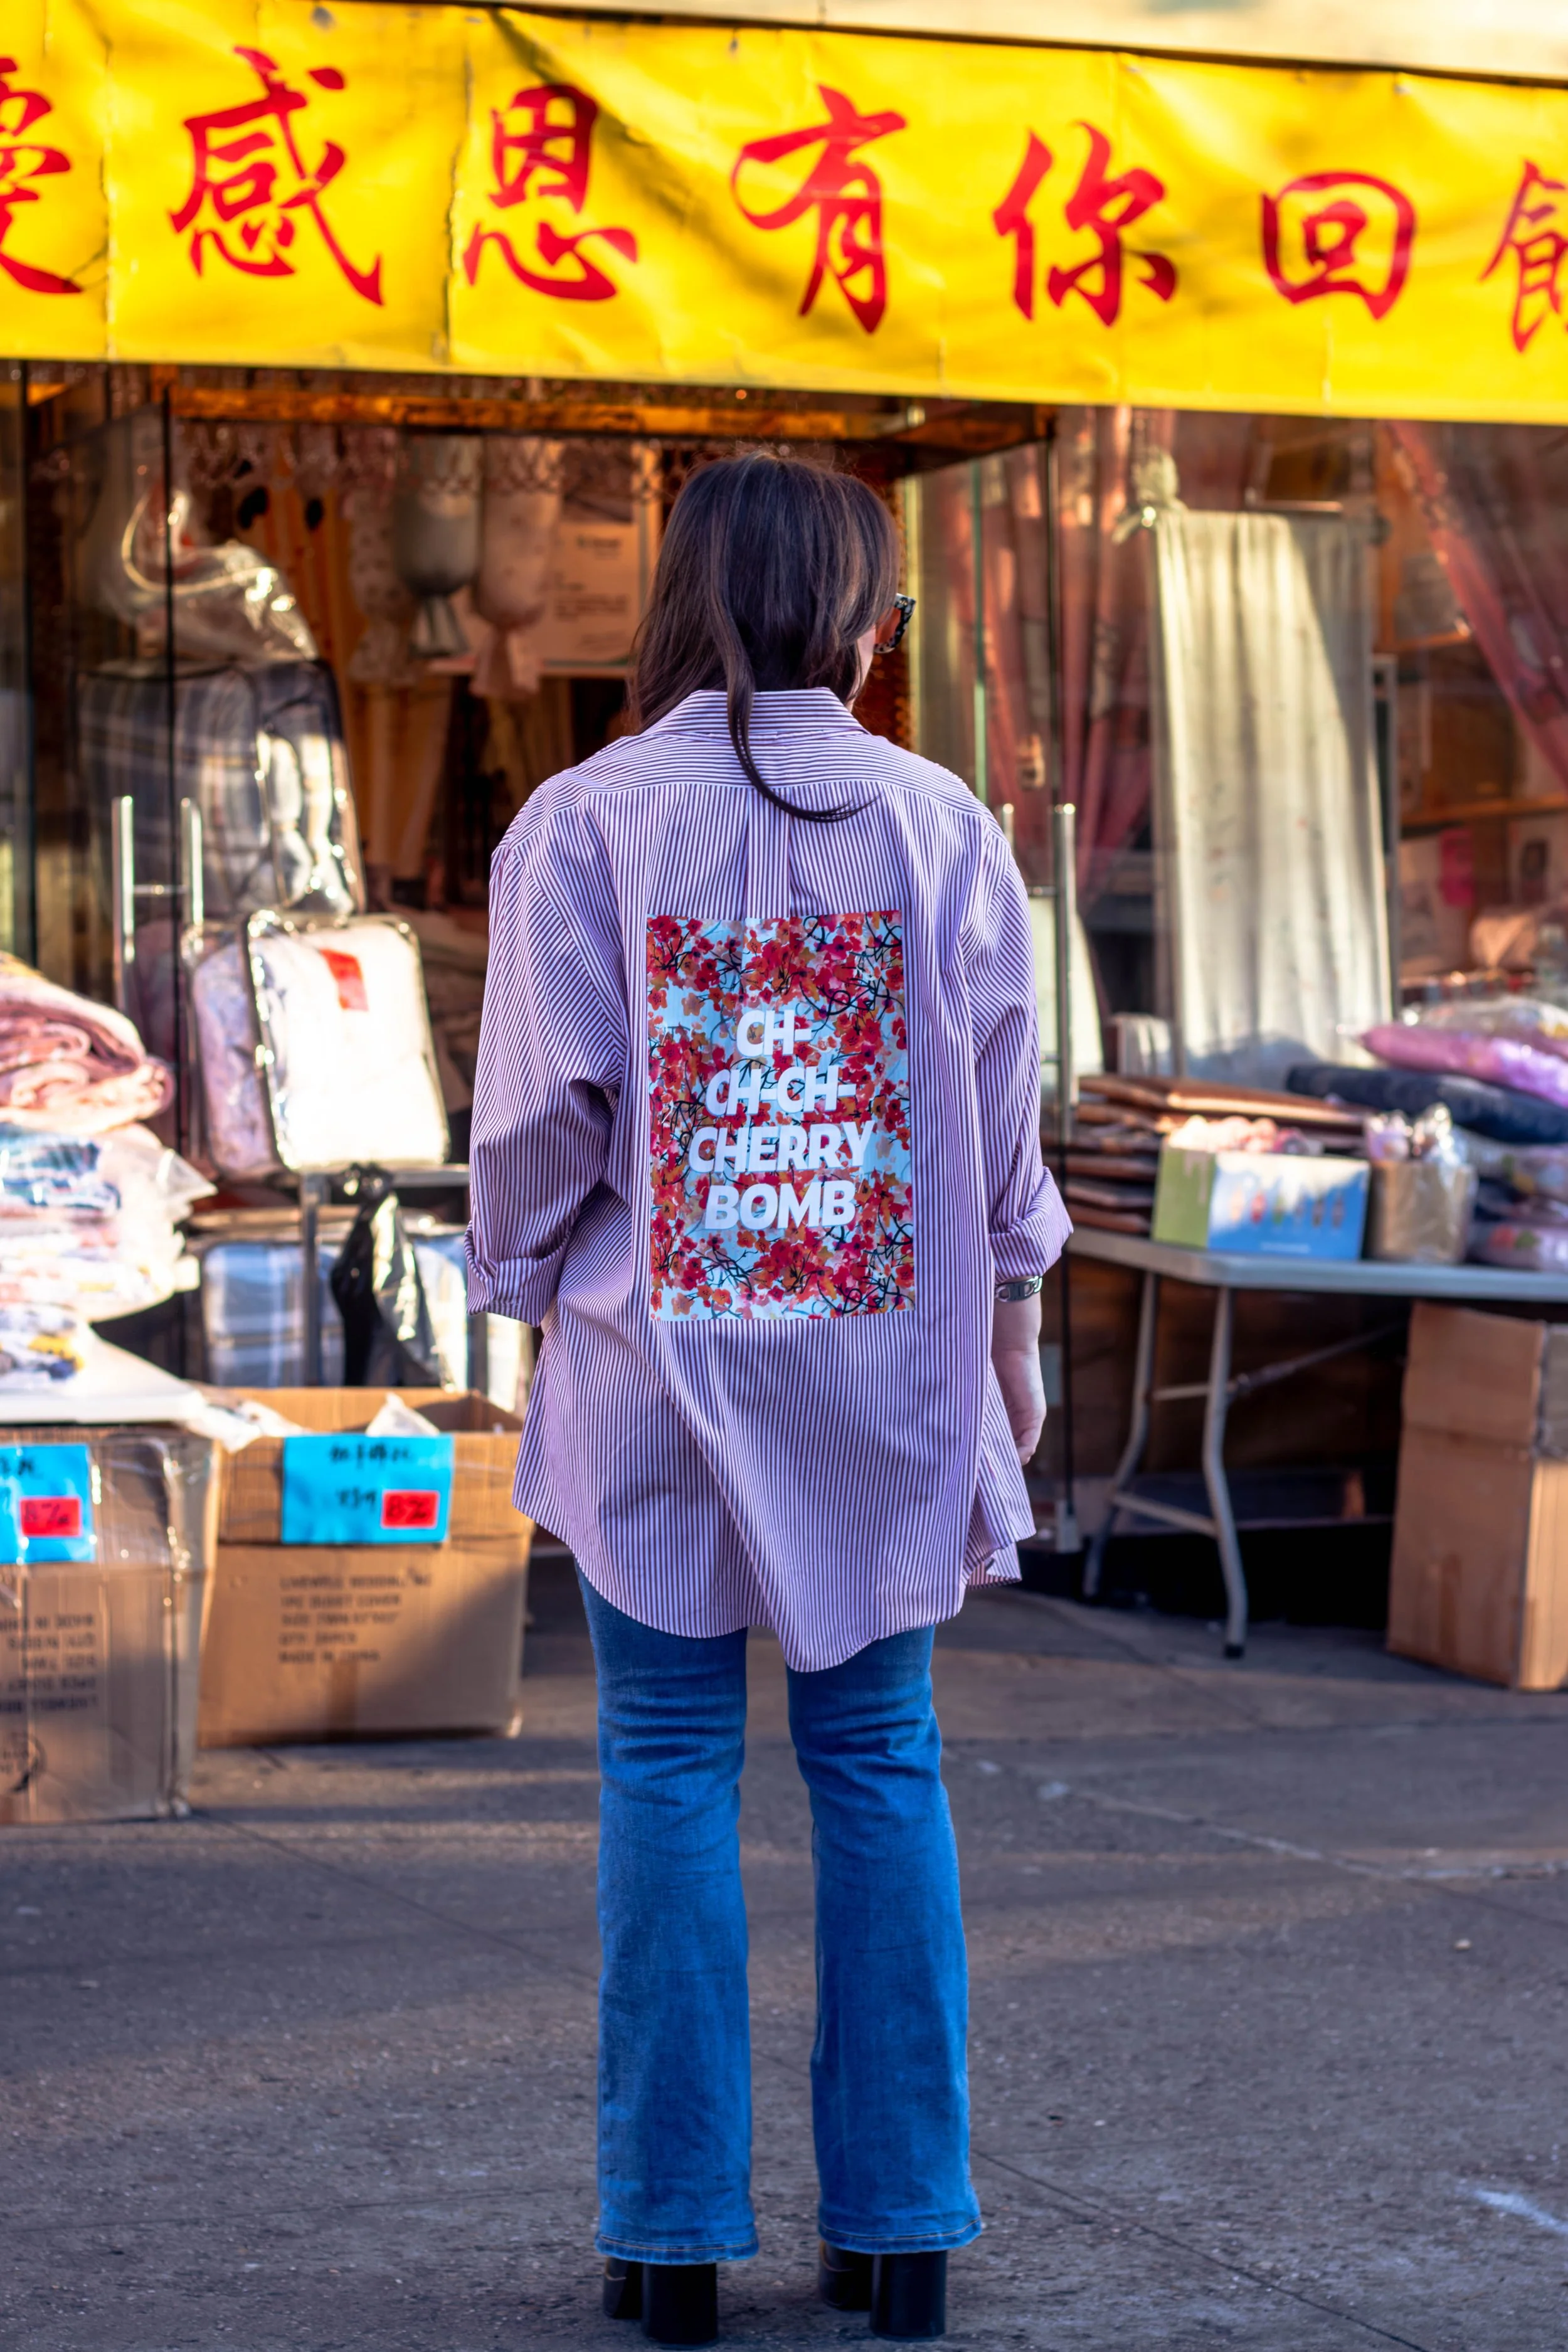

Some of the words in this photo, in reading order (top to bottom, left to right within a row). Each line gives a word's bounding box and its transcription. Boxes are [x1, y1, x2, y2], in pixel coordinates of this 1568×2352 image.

[736, 1009, 812, 1057] CH-
[705, 1064, 856, 1117] CH-CH-
[689, 1120, 875, 1173] CHERRY
[704, 1179, 856, 1231] BOMB
